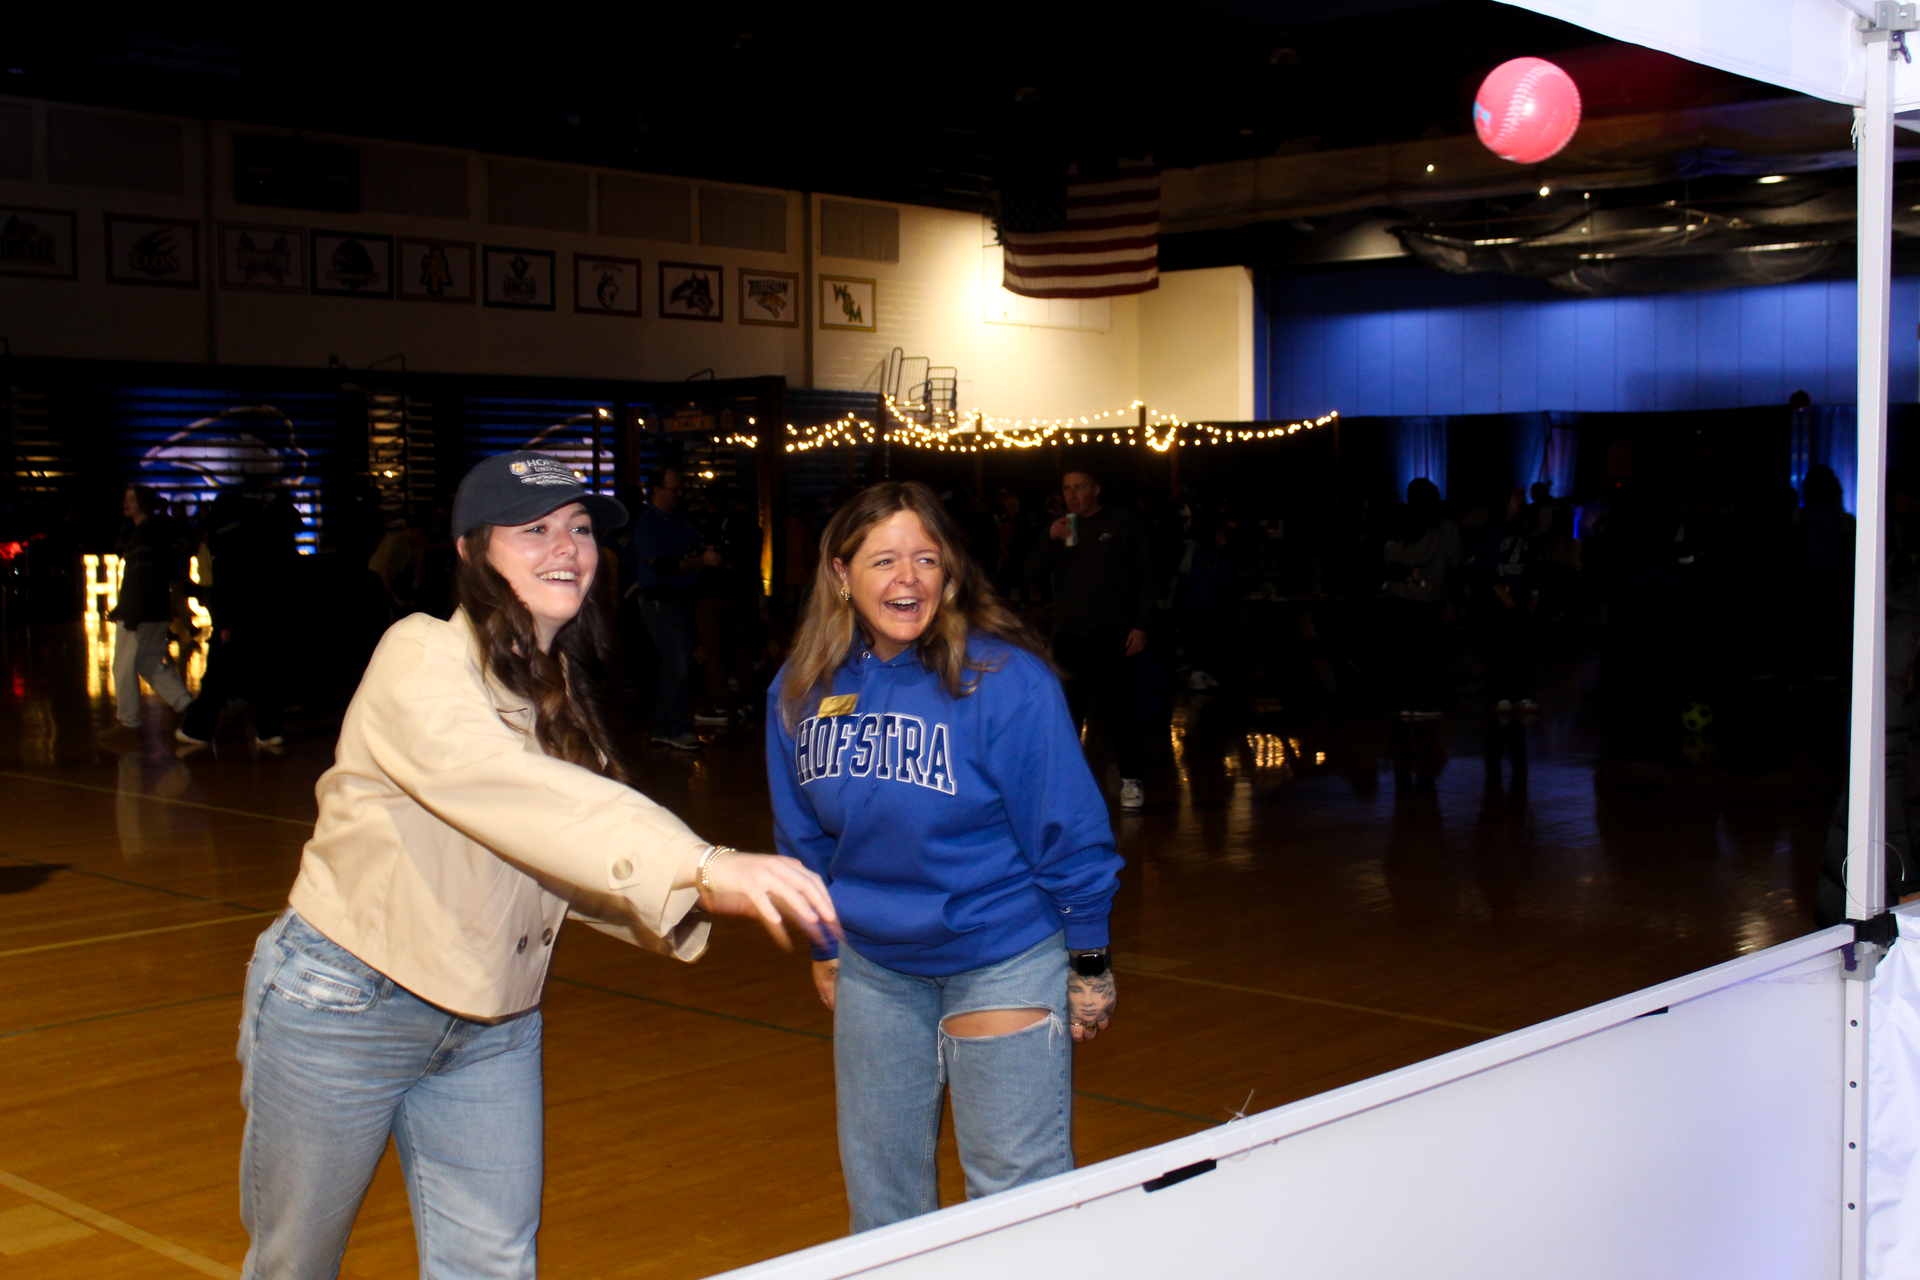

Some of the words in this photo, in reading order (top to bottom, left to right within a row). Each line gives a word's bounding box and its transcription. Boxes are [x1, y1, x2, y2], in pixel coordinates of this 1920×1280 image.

[130, 252, 179, 272] ELON
[503, 279, 537, 295] UNCW
[747, 280, 789, 298] TOWSON
[795, 711, 957, 796] HOFSTRA
